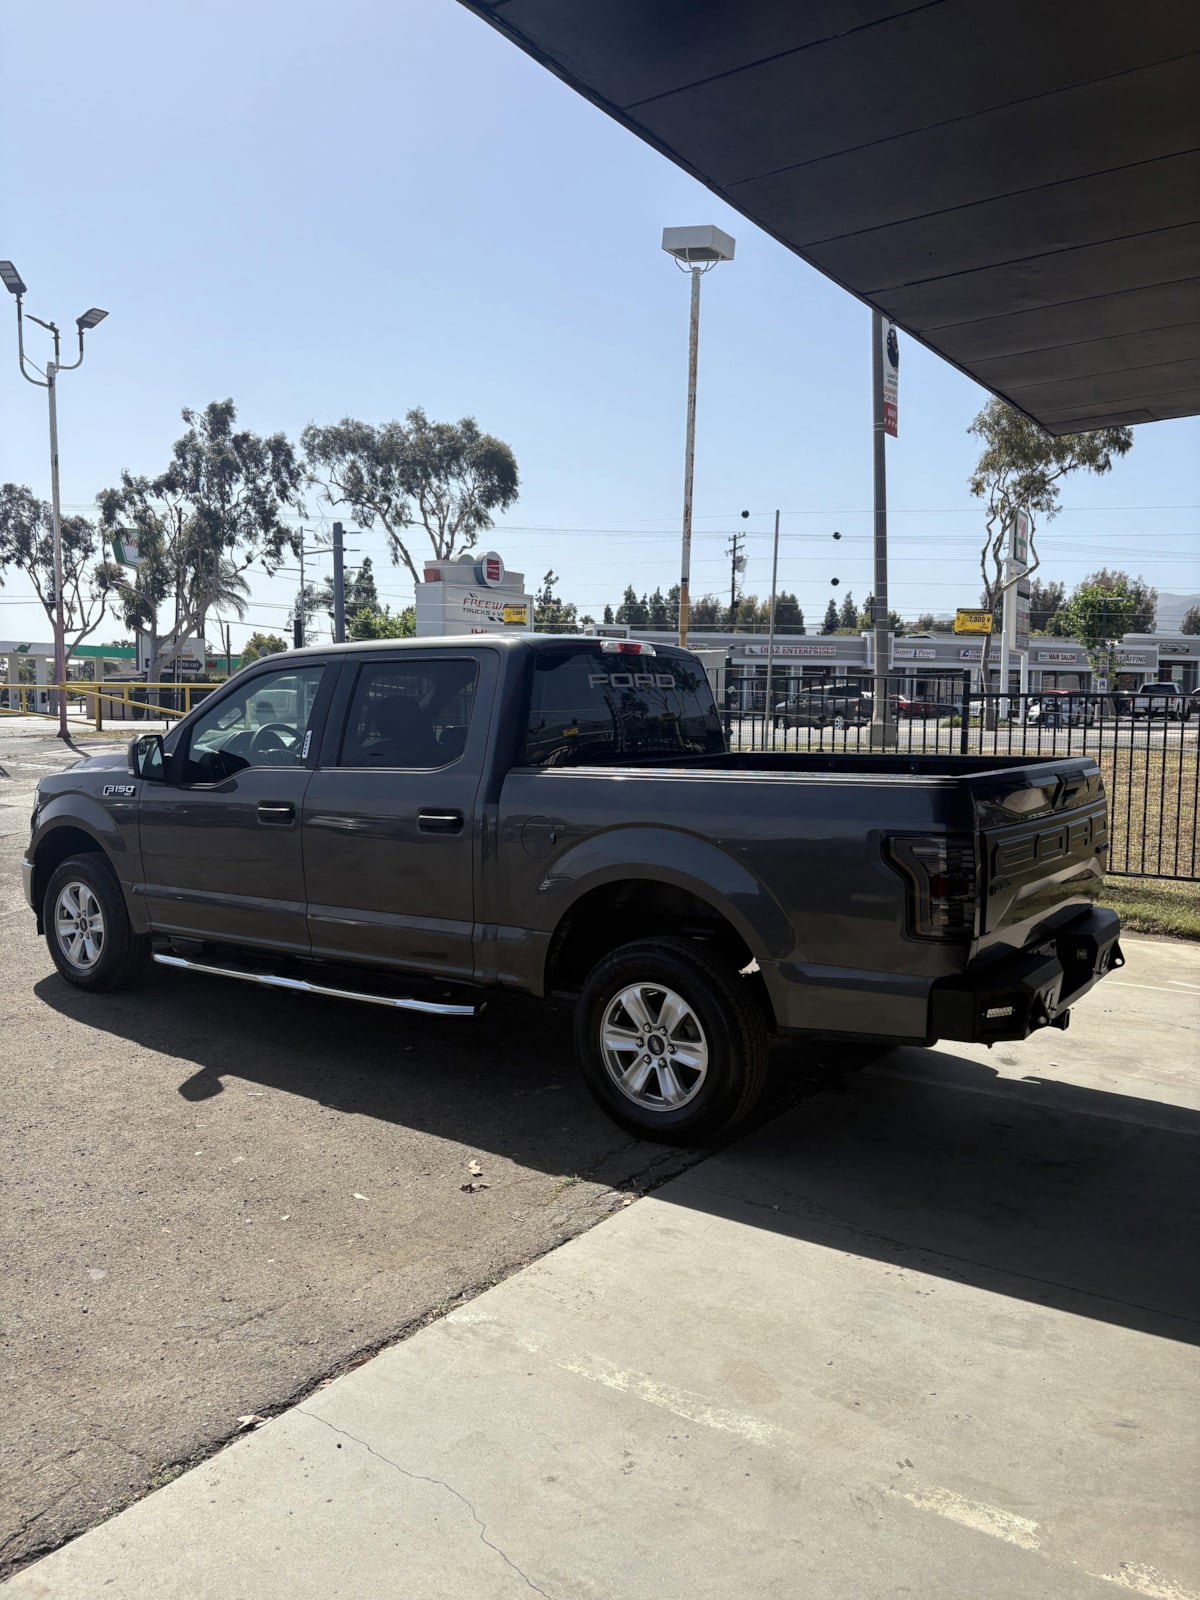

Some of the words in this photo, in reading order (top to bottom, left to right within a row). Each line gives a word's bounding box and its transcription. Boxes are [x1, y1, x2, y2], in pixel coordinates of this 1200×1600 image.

[463, 597, 505, 610] FREEW
[462, 607, 490, 616] TRUCKS
[782, 646, 835, 655] ENTERPRISES
[1061, 653, 1076, 661] SALON
[1119, 654, 1146, 664] STAFFING
[588, 673, 676, 689] FORD
